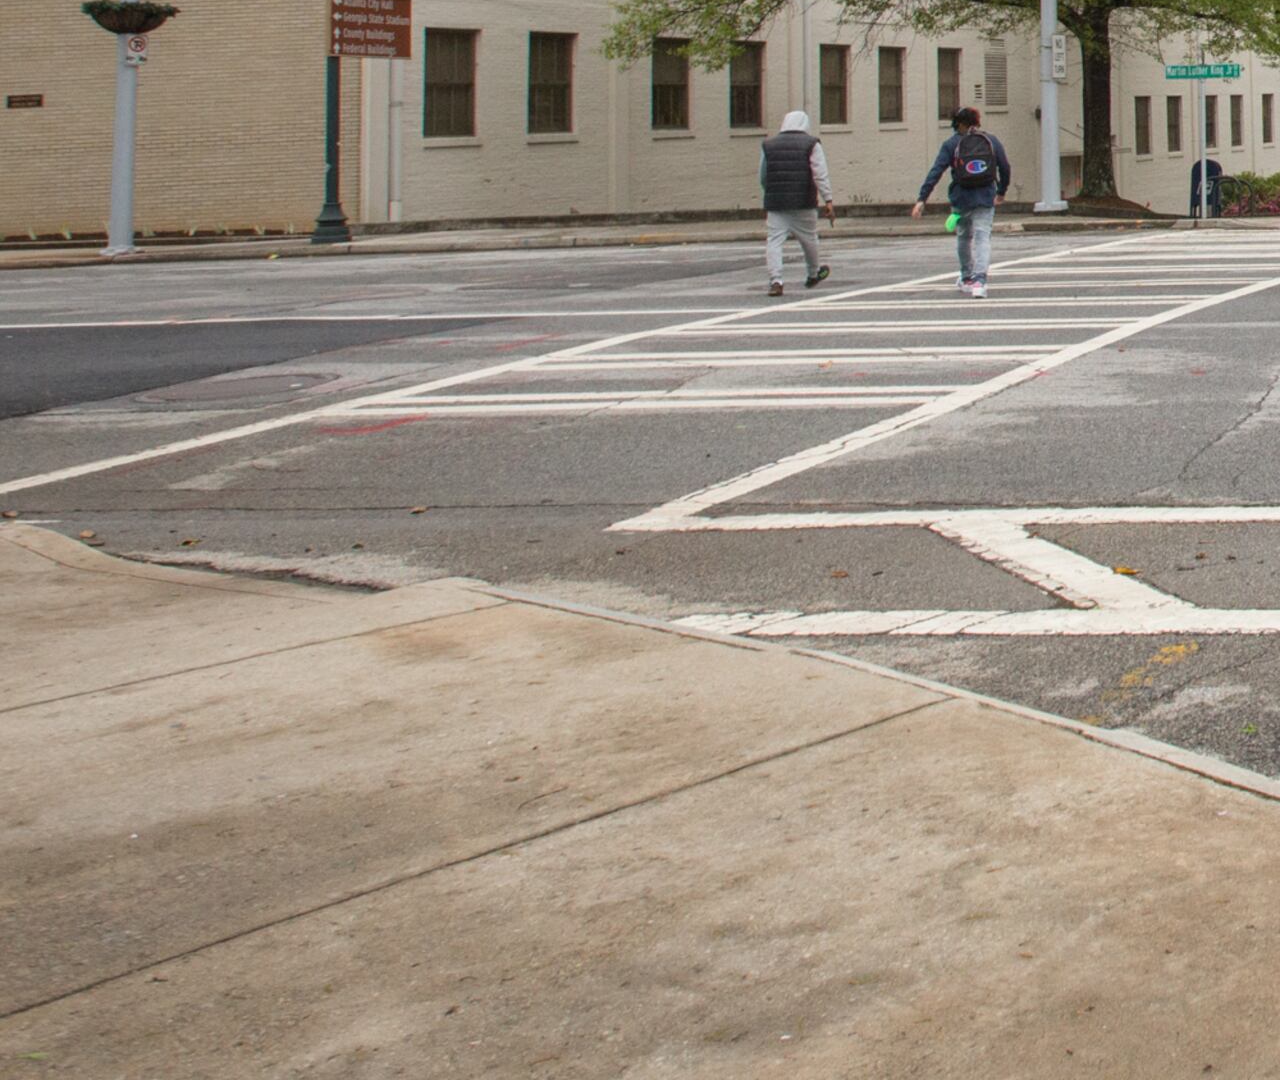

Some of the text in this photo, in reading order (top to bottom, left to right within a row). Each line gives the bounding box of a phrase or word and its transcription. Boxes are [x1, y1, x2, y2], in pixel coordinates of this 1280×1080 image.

[381, 0, 394, 10] Hall
[343, 12, 410, 26] Georgia State Stadium
[343, 27, 396, 43] County Buildings
[343, 43, 397, 57] Federal Buildings
[1167, 65, 1187, 76] Martin
[1188, 65, 1208, 76] Luther
[1210, 64, 1225, 77] King
